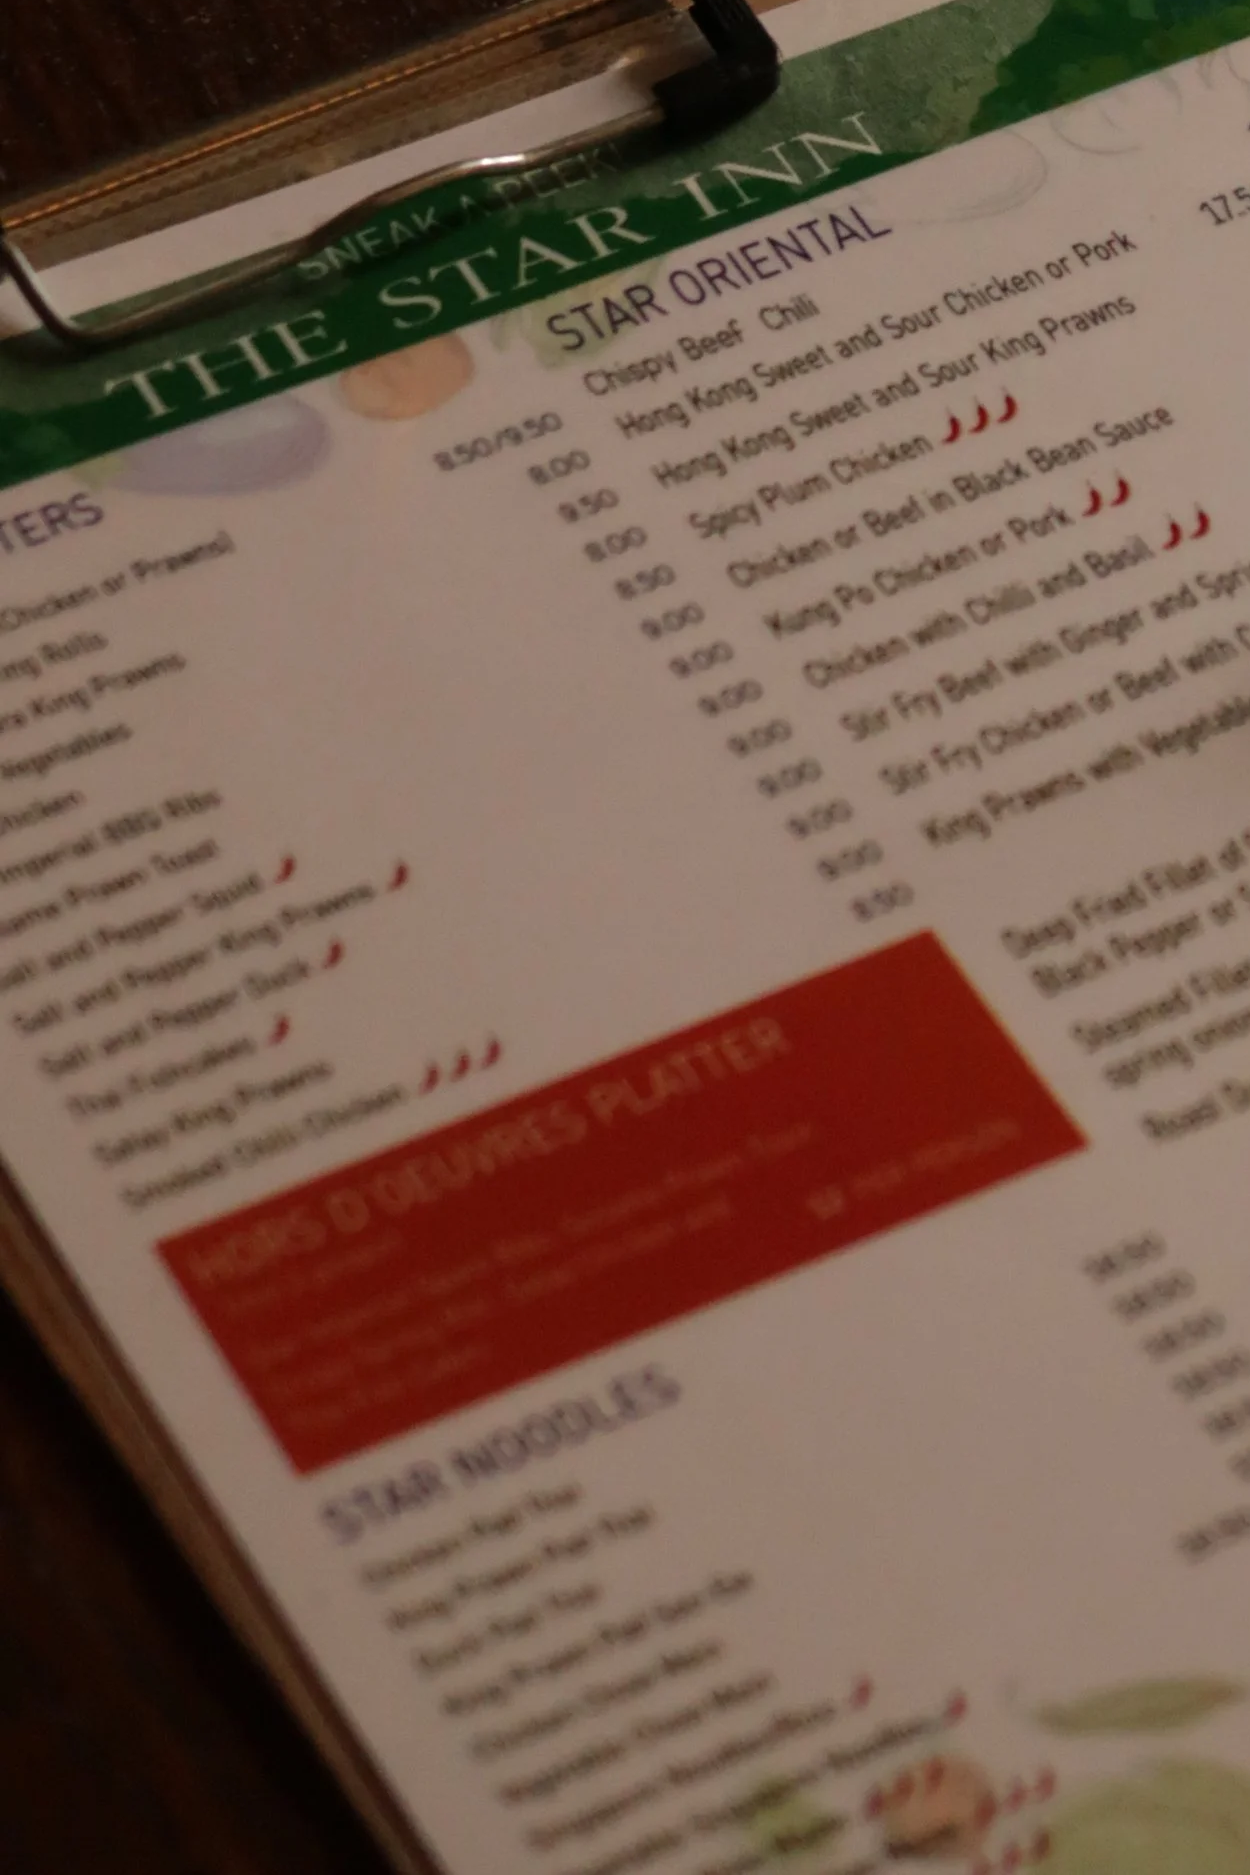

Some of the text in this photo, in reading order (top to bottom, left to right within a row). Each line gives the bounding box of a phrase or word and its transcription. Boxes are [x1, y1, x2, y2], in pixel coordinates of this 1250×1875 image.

[105, 112, 883, 421] THE STAR INN
[297, 207, 437, 280] SNEAK
[500, 140, 621, 196] PEEK!
[546, 205, 893, 352] STAR ORIENTAL
[614, 231, 1138, 439] Hong Kong Sweet and Sour Chicken or Pork
[651, 296, 1137, 488] Hong Kong Sweet and Sour King Prawns
[687, 435, 934, 540] Spicy Plum Chicken
[726, 407, 1175, 589] Chicken or Beef in Black Bean Sauce
[763, 505, 1075, 640] Kung Po Chicken or Pork
[802, 536, 1156, 689] Chicken with Chilli and Basil
[839, 707, 890, 742] Stir
[890, 690, 942, 719] Fry
[935, 658, 1004, 704] Beef
[1002, 640, 1063, 677] with
[1057, 607, 1144, 655] Ginger
[1149, 582, 1200, 621] and
